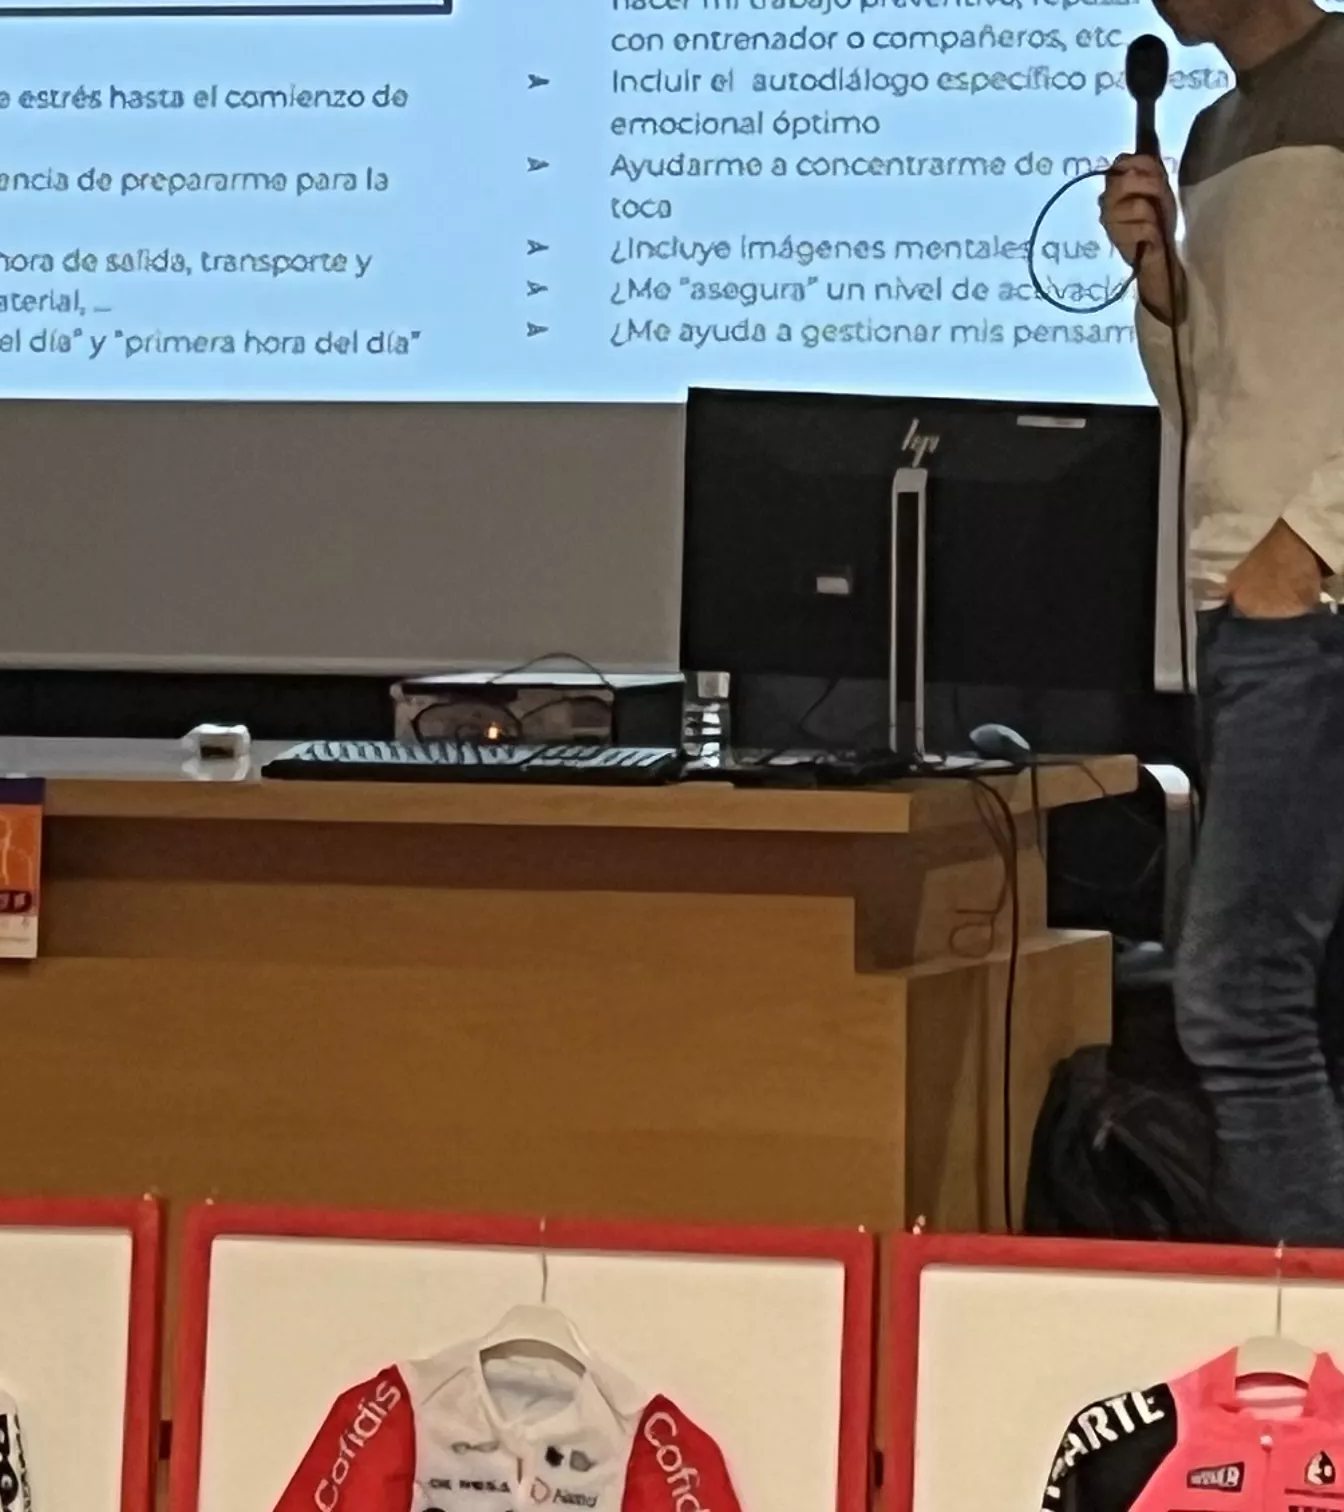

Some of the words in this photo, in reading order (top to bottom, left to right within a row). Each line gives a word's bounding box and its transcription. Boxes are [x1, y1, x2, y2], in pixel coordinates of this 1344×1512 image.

[609, 31, 665, 53] con
[672, 24, 840, 54] entrenador
[871, 22, 1069, 56] compañeros,
[17, 83, 104, 111] estrés
[108, 83, 186, 111] hasta
[223, 83, 367, 110] comienzo
[612, 67, 703, 95] Incluir
[751, 65, 930, 99] autodiálogo
[935, 63, 1087, 97] específico
[609, 109, 765, 137] emocional
[771, 108, 882, 141] óptimo
[119, 170, 289, 198] prepararme
[295, 171, 358, 198] para
[609, 151, 764, 184] Ayudarme
[794, 154, 1008, 178] concentrarme
[609, 196, 673, 220] toca
[105, 247, 193, 277] salida,
[200, 249, 349, 279] transporte
[609, 234, 733, 268] ¿Incluye
[739, 233, 887, 268] imágenes
[892, 233, 1033, 264] mentales
[1041, 236, 1099, 269] que
[609, 275, 673, 307] ¿Me
[873, 275, 944, 303] nivel
[242, 329, 307, 356] hora
[313, 328, 359, 357] del
[609, 316, 672, 349] ¿Me
[677, 317, 767, 351] ayuda
[799, 317, 943, 350] gestionar
[311, 1377, 404, 1512] Cofidis
